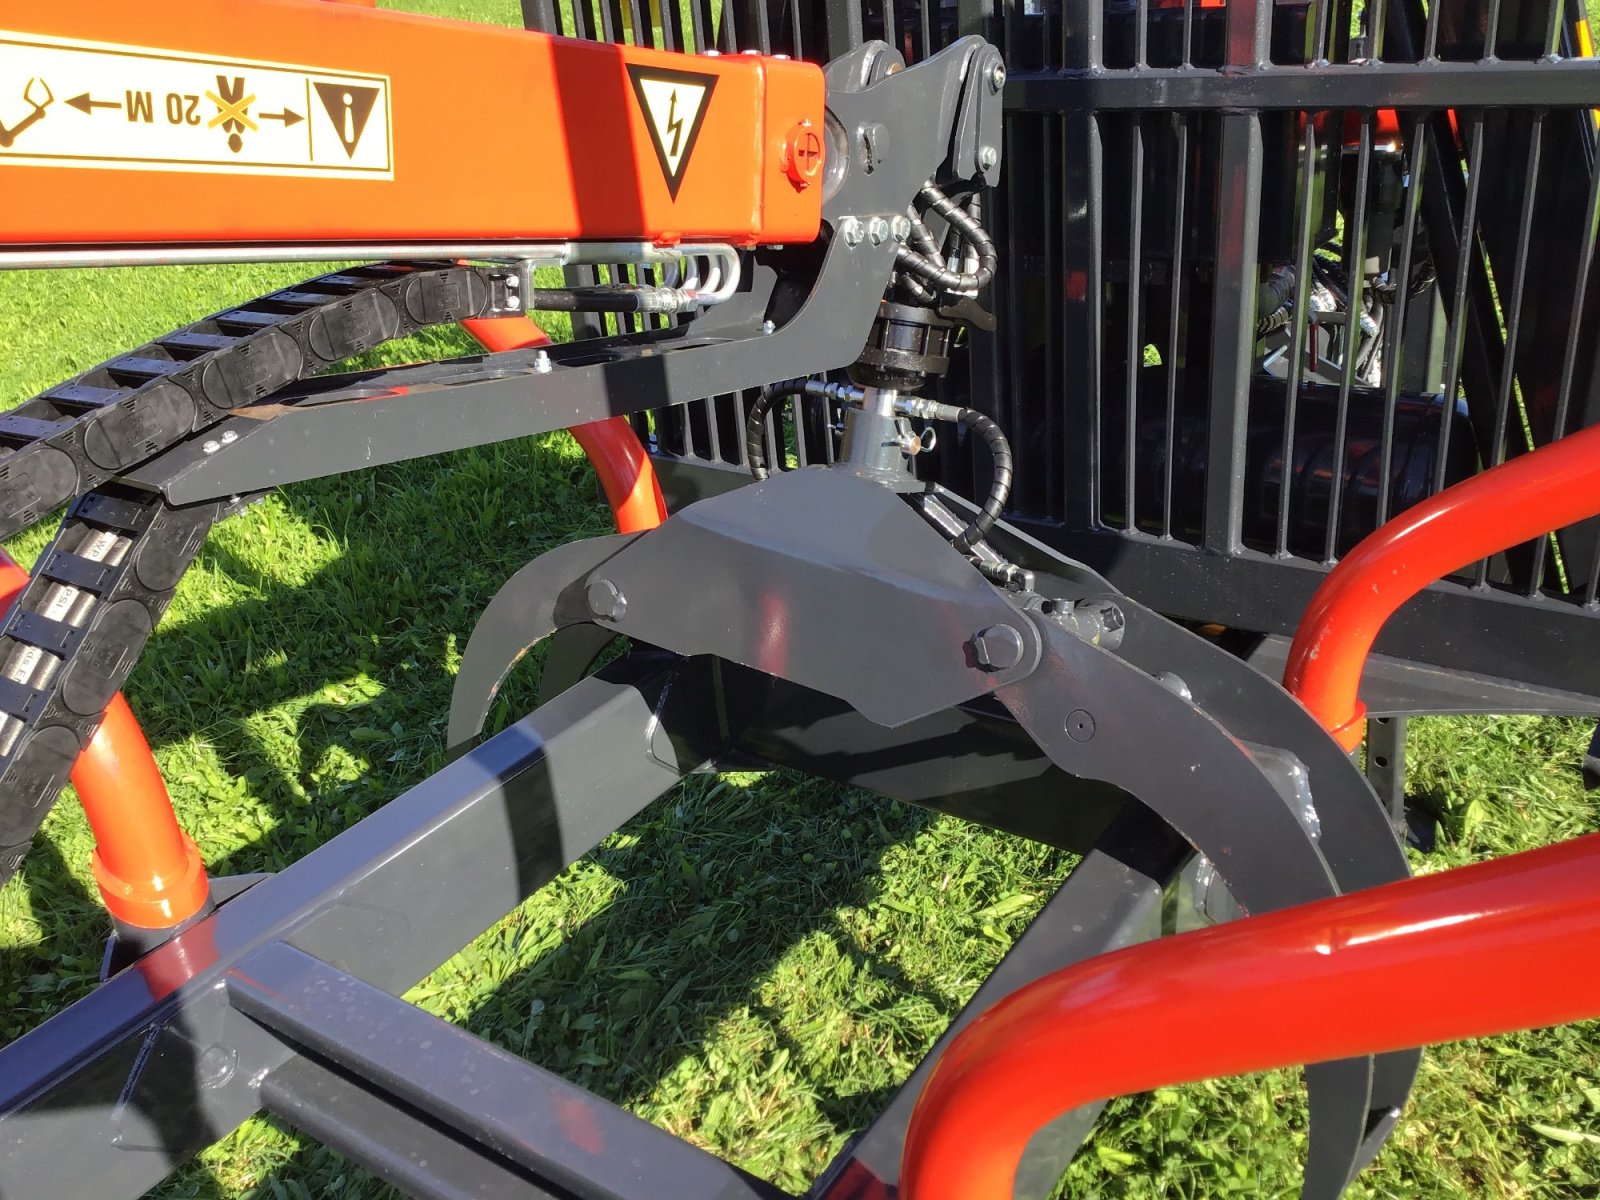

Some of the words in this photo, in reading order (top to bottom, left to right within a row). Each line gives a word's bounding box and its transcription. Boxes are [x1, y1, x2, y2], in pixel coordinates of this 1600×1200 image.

[125, 90, 154, 123] M
[166, 92, 201, 126] 20
[92, 540, 107, 558] WP
